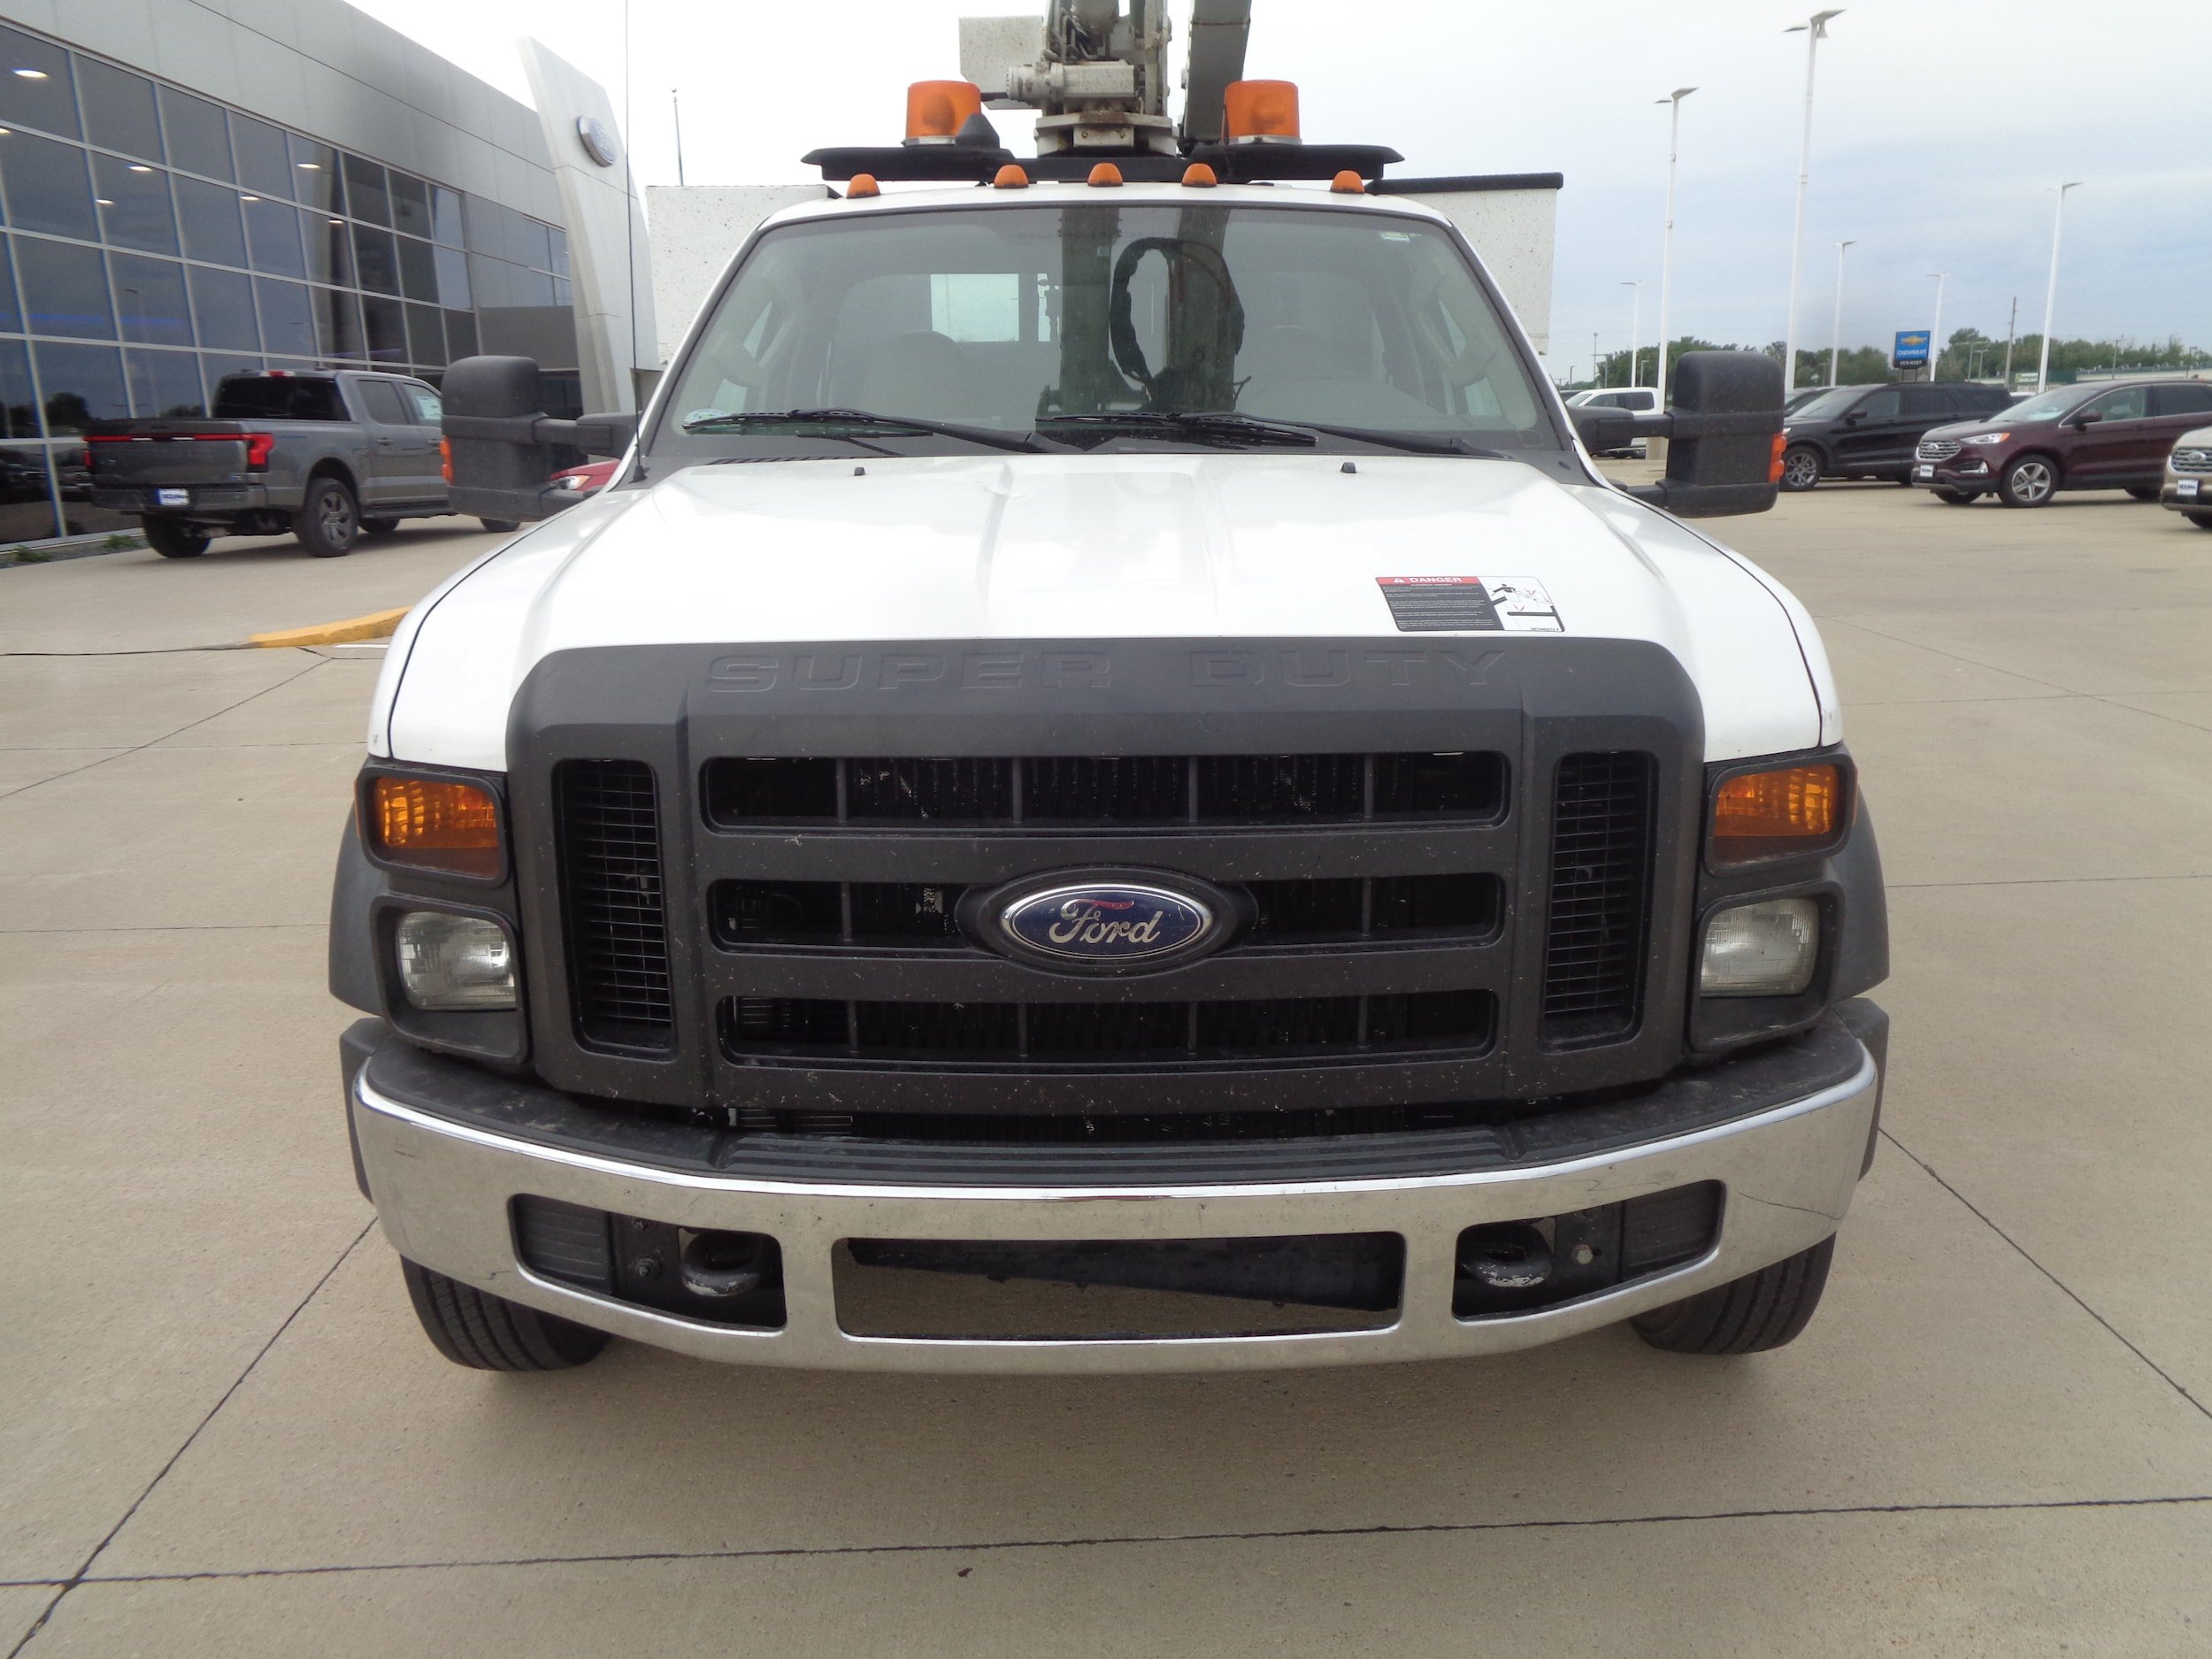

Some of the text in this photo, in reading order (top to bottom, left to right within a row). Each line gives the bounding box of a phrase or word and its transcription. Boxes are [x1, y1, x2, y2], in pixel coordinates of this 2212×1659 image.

[709, 649, 1507, 693] SUPER DUTY
[1048, 898, 1163, 944] Ford
